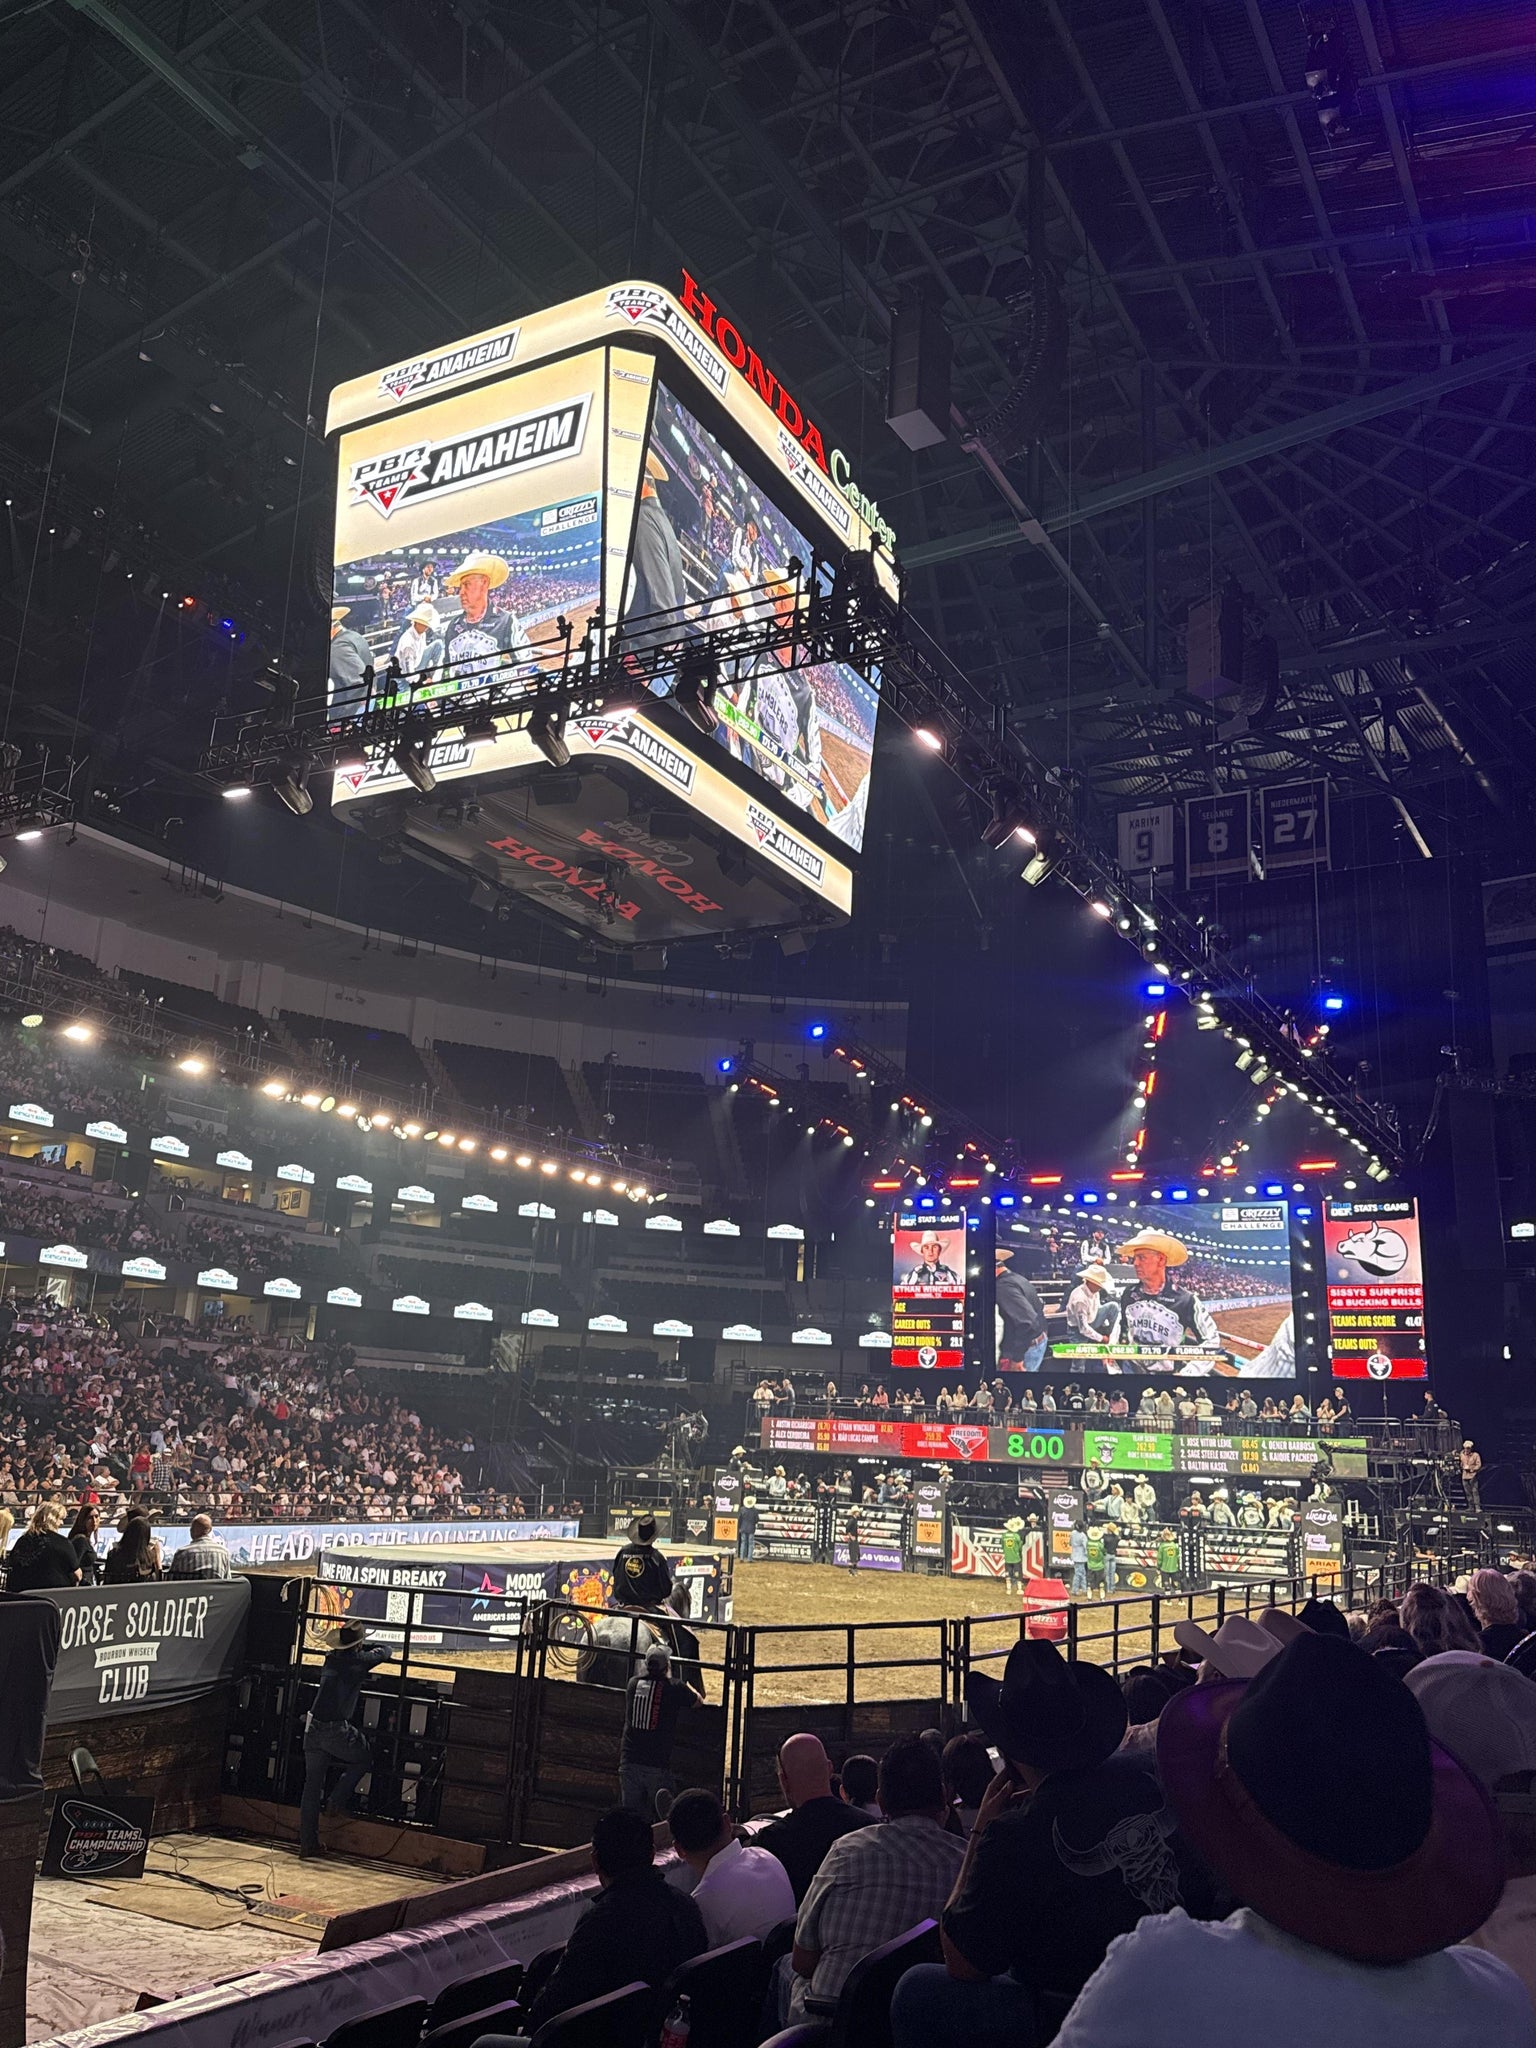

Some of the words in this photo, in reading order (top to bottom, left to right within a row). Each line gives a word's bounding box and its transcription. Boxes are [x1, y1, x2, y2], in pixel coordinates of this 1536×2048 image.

[666, 313, 725, 386] ANAHEIM
[426, 336, 510, 383] ANAHEIM
[680, 268, 829, 475] HONDA
[831, 449, 896, 551] Center
[431, 410, 575, 485] ANAHEIM
[368, 471, 410, 491] TEAMS
[805, 469, 849, 529] ANAHEIM
[543, 515, 595, 534] CHALLENGE
[382, 745, 466, 777] AEIM
[628, 728, 691, 783] ANAHEIM
[1129, 815, 1160, 830] KARIYA
[1273, 809, 1318, 844] 27
[1208, 822, 1228, 852] 8
[1136, 831, 1153, 862] 9
[775, 831, 820, 878] ANAHEIM
[577, 829, 724, 913] HONDA
[1240, 1208, 1281, 1217] GRIZZLY
[1354, 1204, 1378, 1212] STATS
[1383, 1203, 1409, 1211] GAME
[918, 1215, 936, 1223] STATS
[1330, 1288, 1367, 1296] SISSYS
[1369, 1288, 1421, 1296] SURPRISE
[1391, 1298, 1421, 1306] BULLS
[894, 1319, 916, 1330] CAREER
[916, 1319, 931, 1330] OUTS
[1332, 1315, 1357, 1327] TEAMS
[1357, 1315, 1372, 1327] AVG
[1372, 1315, 1397, 1327] SCORE
[894, 1336, 916, 1346] CAREER
[1333, 1339, 1358, 1350] TEAMS
[1358, 1339, 1378, 1350] OUTS
[1176, 1346, 1203, 1355] FLORIDA
[775, 1430, 786, 1438] ALEX
[1008, 1434, 1064, 1460] 8.00
[1200, 1438, 1216, 1447] VITOR
[1269, 1441, 1287, 1450] DENER
[1288, 1441, 1316, 1451] BARBOSA
[1187, 1450, 1200, 1459] SAGE
[1201, 1450, 1218, 1459] STEELE
[1291, 1453, 1318, 1462] PACHECO
[1188, 1461, 1209, 1470] DALTON
[1306, 1513, 1327, 1521] LUCAS
[1327, 1513, 1337, 1521] OIL
[614, 1517, 633, 1531] HORS
[251, 1534, 315, 1562] HEAD
[321, 1532, 364, 1551] FOR
[369, 1531, 408, 1546] THE
[1213, 1546, 1246, 1554] TEAMS
[874, 1555, 900, 1563] VEGAS
[336, 1564, 352, 1582] FOR
[353, 1566, 359, 1582] A
[360, 1567, 389, 1585] SPIN
[392, 1569, 447, 1587] BREAK?
[59, 1603, 119, 1650] ORSE
[126, 1595, 209, 1639] SOLDIER
[472, 1613, 506, 1622] AMERICA'S
[99, 1649, 126, 1662] BOURBON
[128, 1646, 155, 1658] WHISKEY
[98, 1665, 150, 1704] CLUB
[106, 1830, 139, 1840] TEAMS
[69, 1840, 143, 1850] CHAMPIONSHIP
